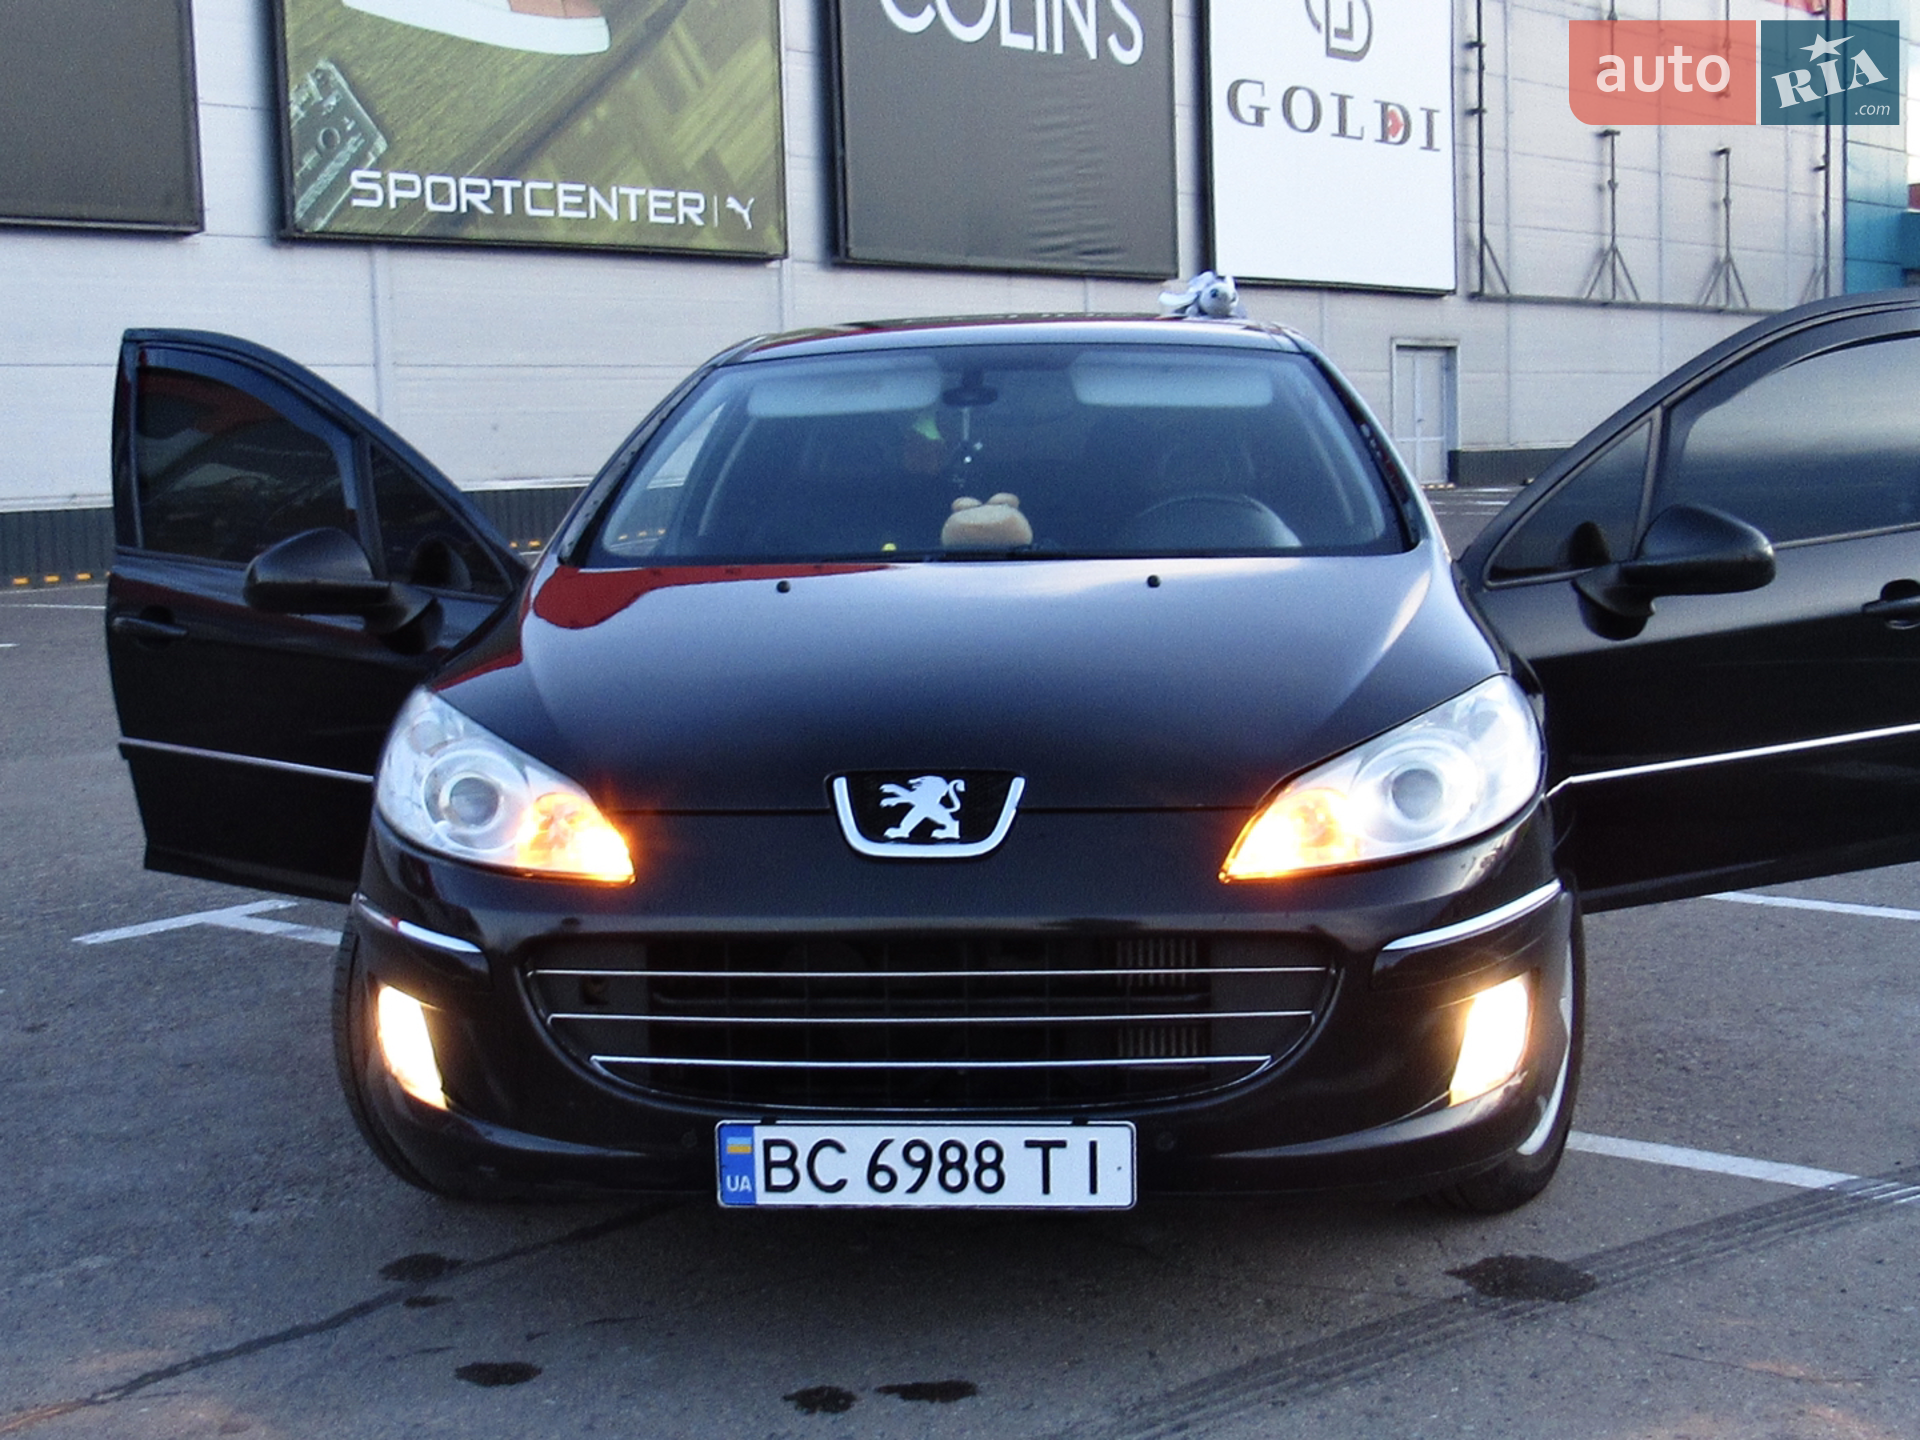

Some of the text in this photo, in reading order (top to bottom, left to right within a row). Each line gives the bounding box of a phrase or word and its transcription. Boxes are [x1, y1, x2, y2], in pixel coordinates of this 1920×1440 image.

[1226, 78, 1441, 152] GOLDI
[350, 169, 706, 226] SPORTCENTER
[726, 1175, 752, 1192] UA
[762, 1138, 848, 1195] BC
[866, 1138, 1006, 1195] 6988
